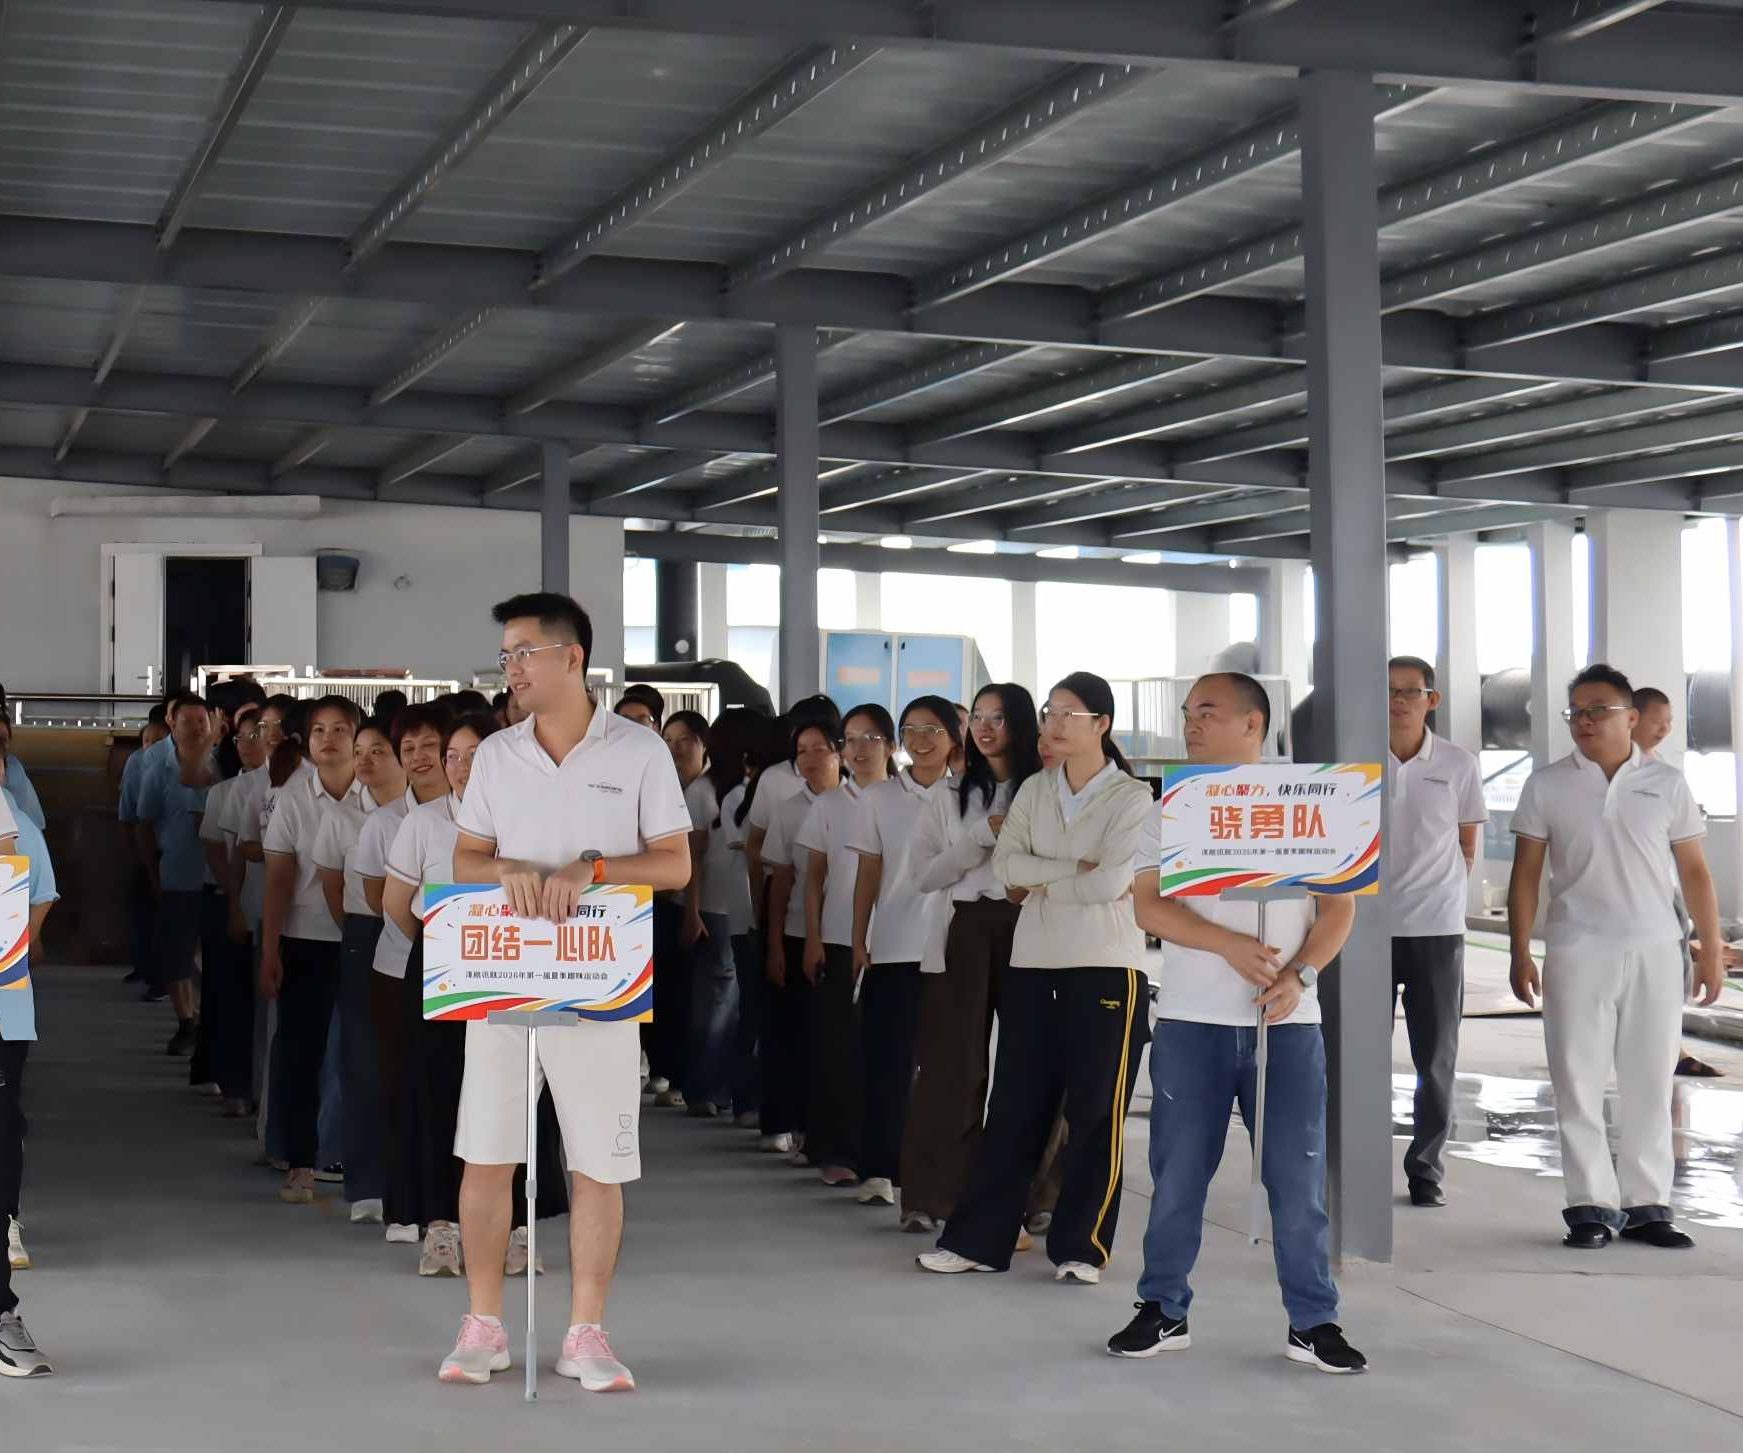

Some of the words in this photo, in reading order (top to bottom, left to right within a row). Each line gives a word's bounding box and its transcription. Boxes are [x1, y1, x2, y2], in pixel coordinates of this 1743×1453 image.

[1210, 804, 1326, 839] 骁勇队
[461, 925, 616, 961] 团结一心队
